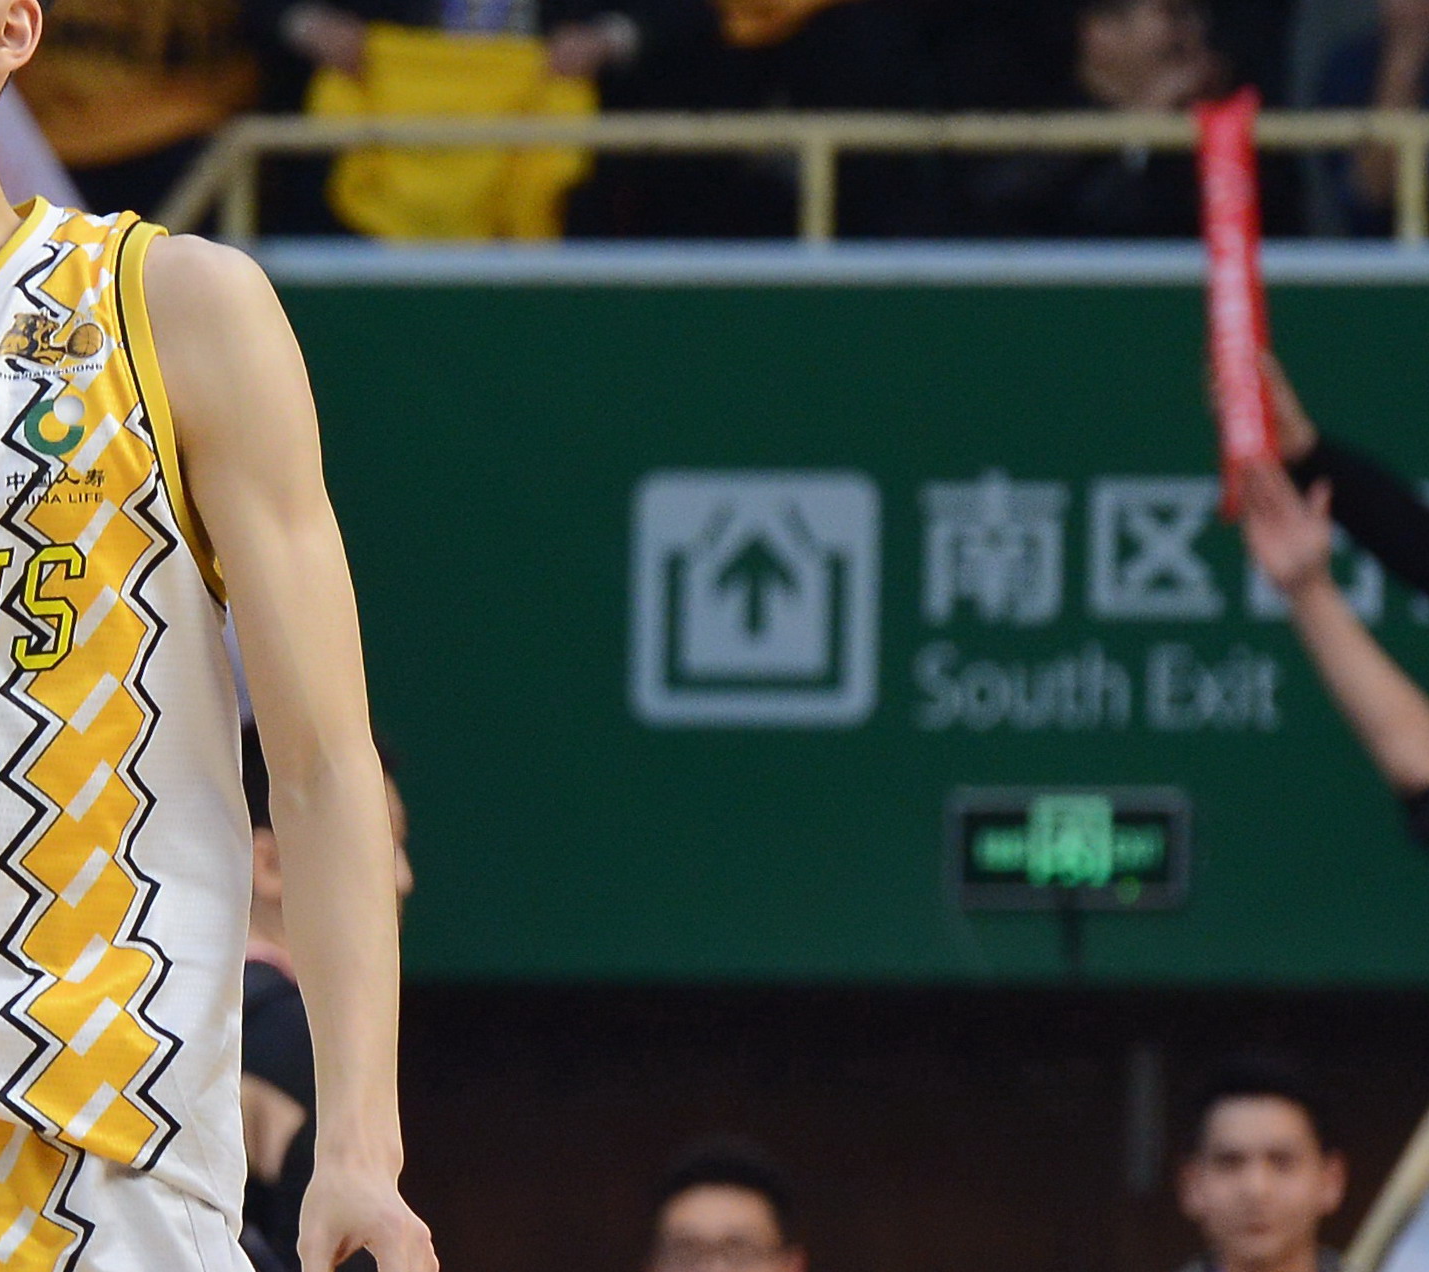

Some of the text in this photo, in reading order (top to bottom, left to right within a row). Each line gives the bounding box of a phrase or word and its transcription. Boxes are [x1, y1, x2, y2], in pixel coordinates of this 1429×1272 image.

[68, 492, 104, 504] LIFE
[912, 640, 1282, 730] South Exit
